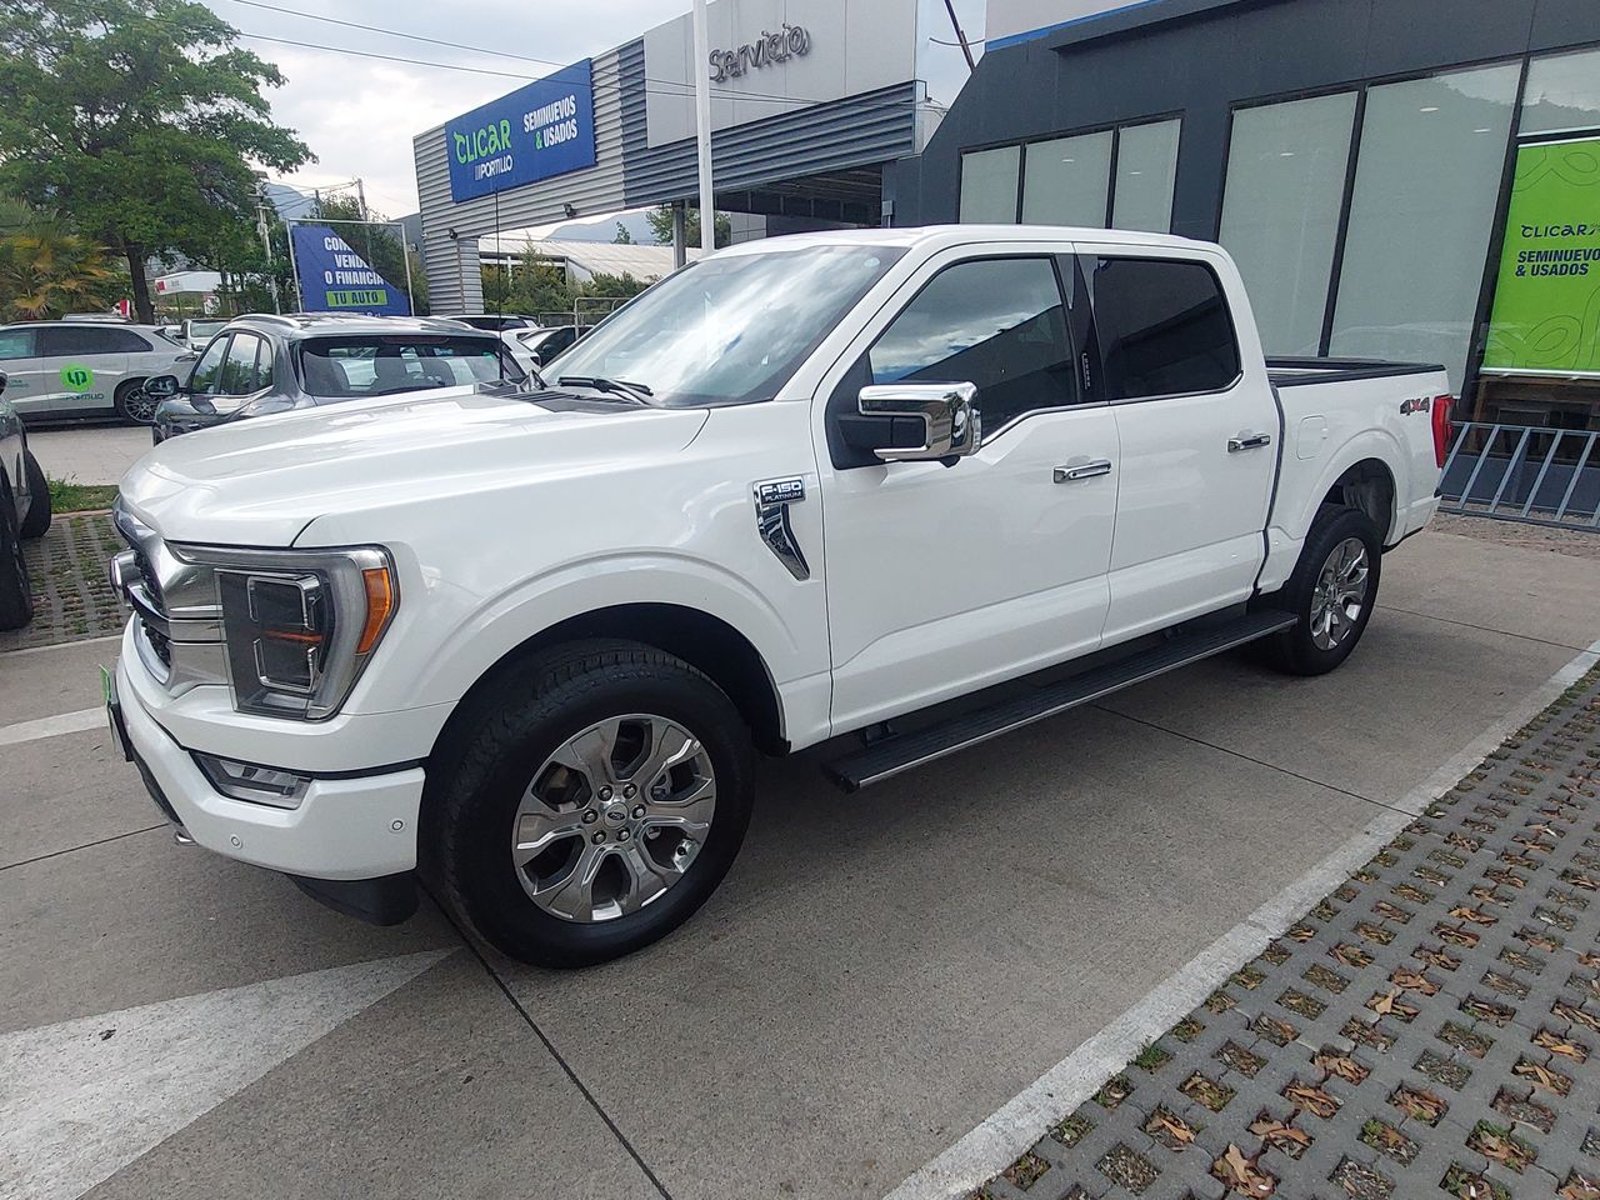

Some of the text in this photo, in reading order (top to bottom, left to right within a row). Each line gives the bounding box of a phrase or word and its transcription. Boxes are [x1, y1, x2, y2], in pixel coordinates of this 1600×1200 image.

[708, 23, 810, 83] Servicio
[523, 94, 576, 133] SEMINUEVOS
[535, 118, 578, 150] & USADOS
[479, 155, 514, 179] PORTILLO
[324, 236, 353, 251] COM
[1515, 263, 1589, 277] & USADOS
[324, 270, 385, 286] O FINANCIA
[333, 291, 379, 305] TU AUTO
[761, 481, 802, 496] F-150
[765, 491, 802, 502] PLATINUM
